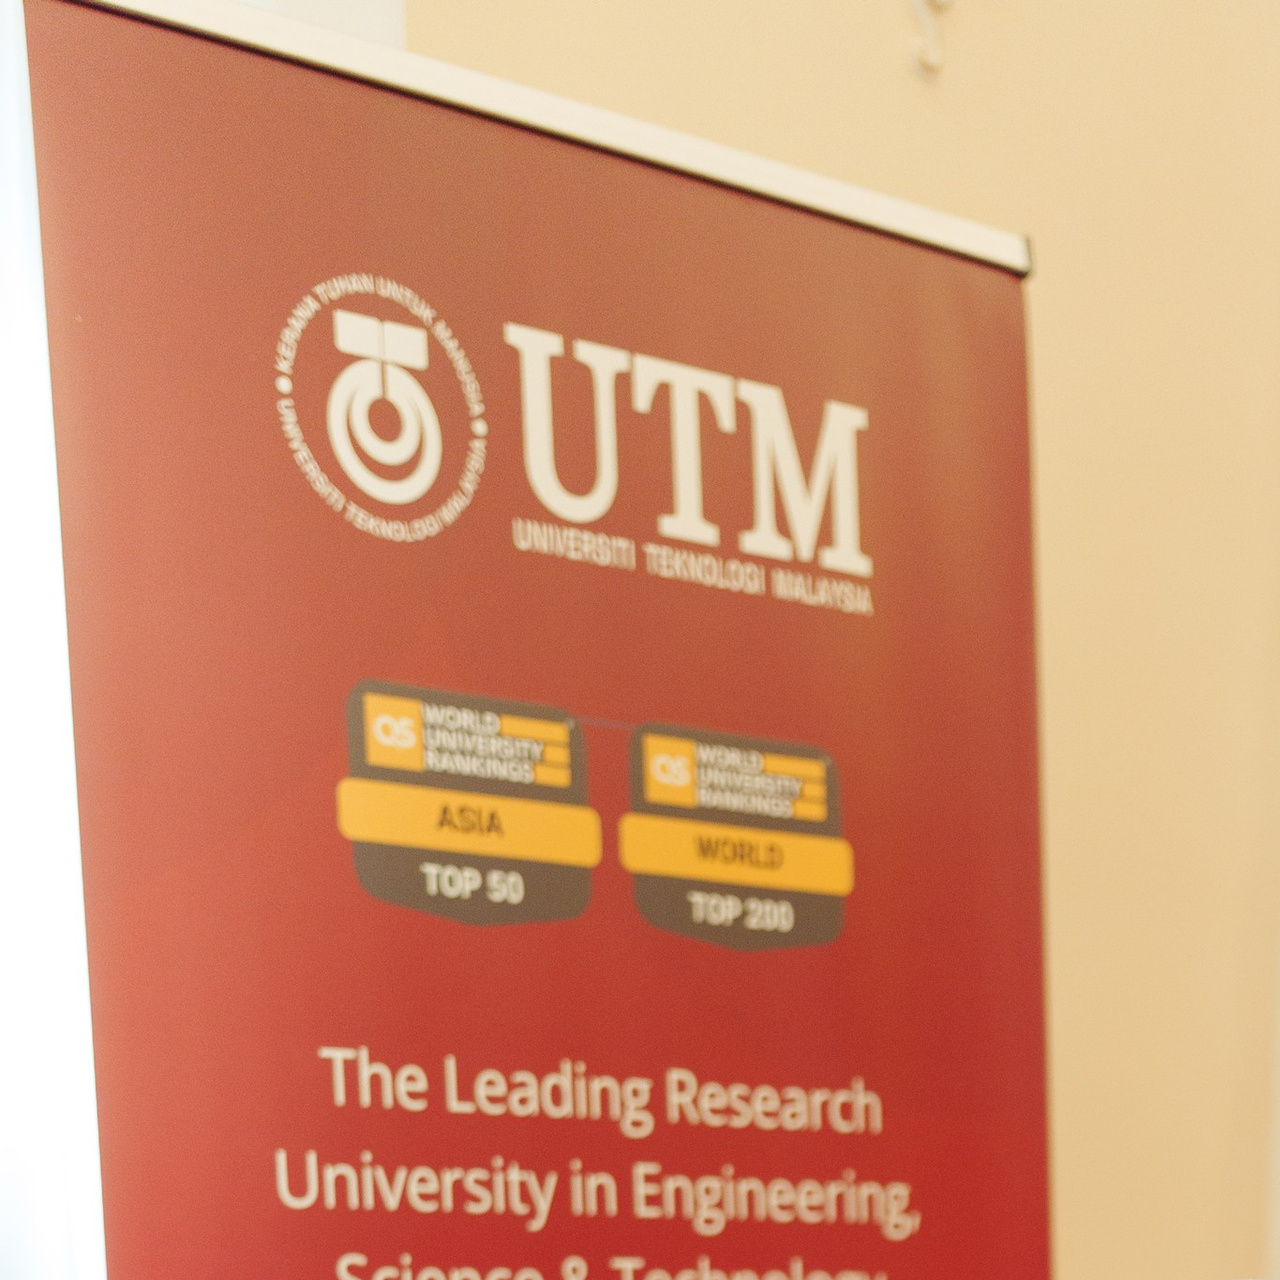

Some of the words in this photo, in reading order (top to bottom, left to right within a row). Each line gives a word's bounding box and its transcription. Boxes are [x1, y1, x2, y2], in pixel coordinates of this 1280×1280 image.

[275, 293, 322, 375] KERANA
[311, 272, 376, 304] TUHAN
[375, 275, 437, 326] UNTUK
[431, 318, 486, 418] MANUSIA
[503, 320, 874, 578] UTM
[275, 397, 346, 514] UNIVERSITI
[344, 500, 441, 542] TEKNOLOGI
[512, 516, 637, 573] UNIVERSITI
[643, 542, 766, 598] TEKNOLOGI
[771, 567, 875, 617] MALAYSIA
[370, 713, 418, 751] QS
[421, 700, 502, 737] WORLD
[423, 726, 546, 763] UNIVERSITY
[695, 740, 764, 775] WORLD
[425, 749, 536, 786] RANKINGS
[651, 752, 692, 788] QS
[697, 764, 804, 800] UNIVERSITY
[436, 804, 506, 838] ASIA
[696, 785, 796, 820] RANKINGS
[693, 833, 784, 870] WORLD
[419, 862, 482, 899] TOP
[486, 868, 526, 905] 50
[687, 889, 743, 926] TOP
[744, 897, 796, 933] 200
[316, 1045, 429, 1113] The
[443, 1052, 656, 1139] Leading
[664, 1066, 883, 1136] Research
[274, 1147, 558, 1233] University
[569, 1157, 618, 1218] in
[632, 1160, 922, 1242] Engineering,
